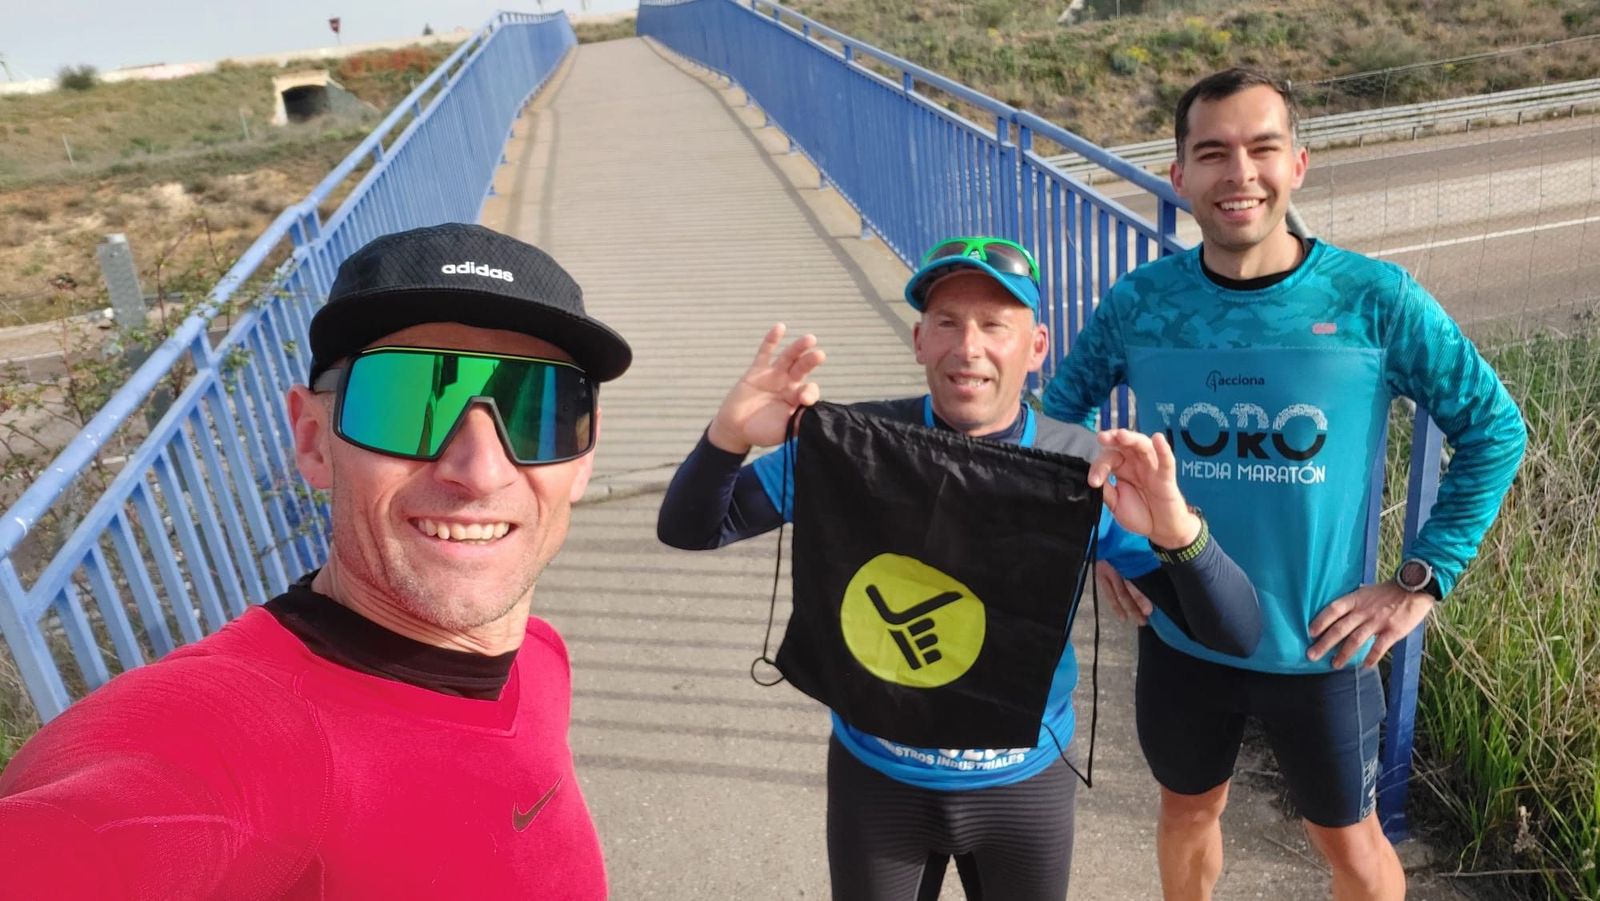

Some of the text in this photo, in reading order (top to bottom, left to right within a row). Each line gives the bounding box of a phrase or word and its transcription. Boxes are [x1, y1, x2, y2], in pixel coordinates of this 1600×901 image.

[441, 261, 514, 282] adidas
[1218, 373, 1265, 386] acciona
[1155, 402, 1328, 461] TORO
[1181, 459, 1326, 484] MEDIA MARATÓN
